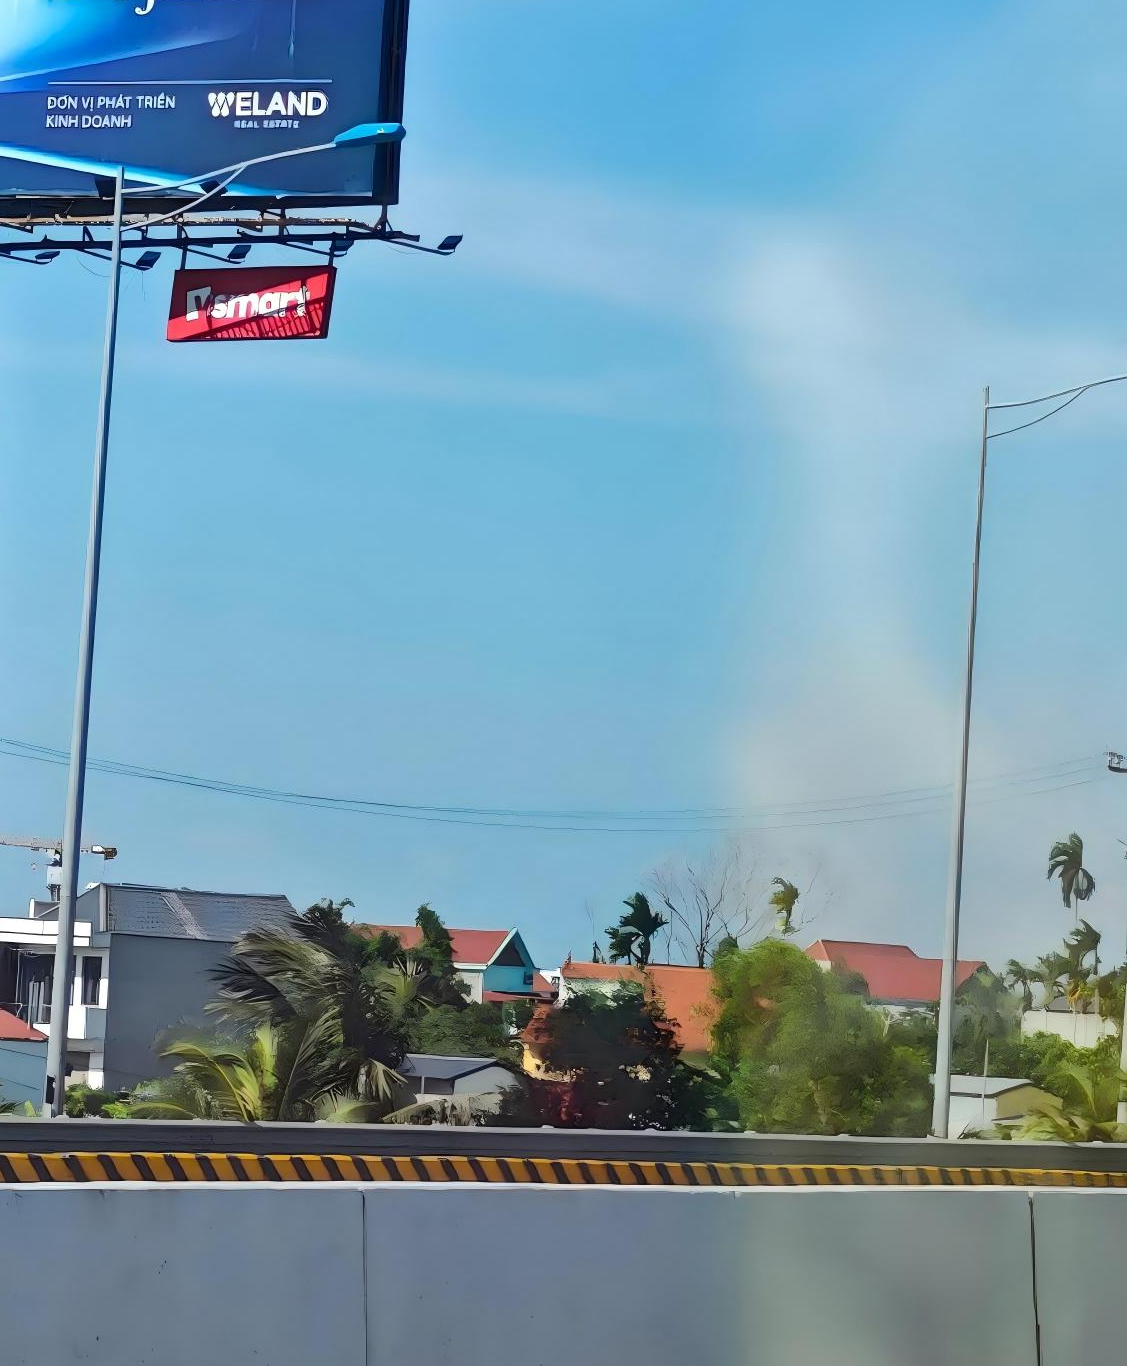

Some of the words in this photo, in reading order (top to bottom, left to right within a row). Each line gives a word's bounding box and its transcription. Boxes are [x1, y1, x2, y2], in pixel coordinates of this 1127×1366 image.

[97, 93, 132, 109] PHÁT
[46, 114, 79, 128] KINH
[81, 114, 132, 128] DOANH
